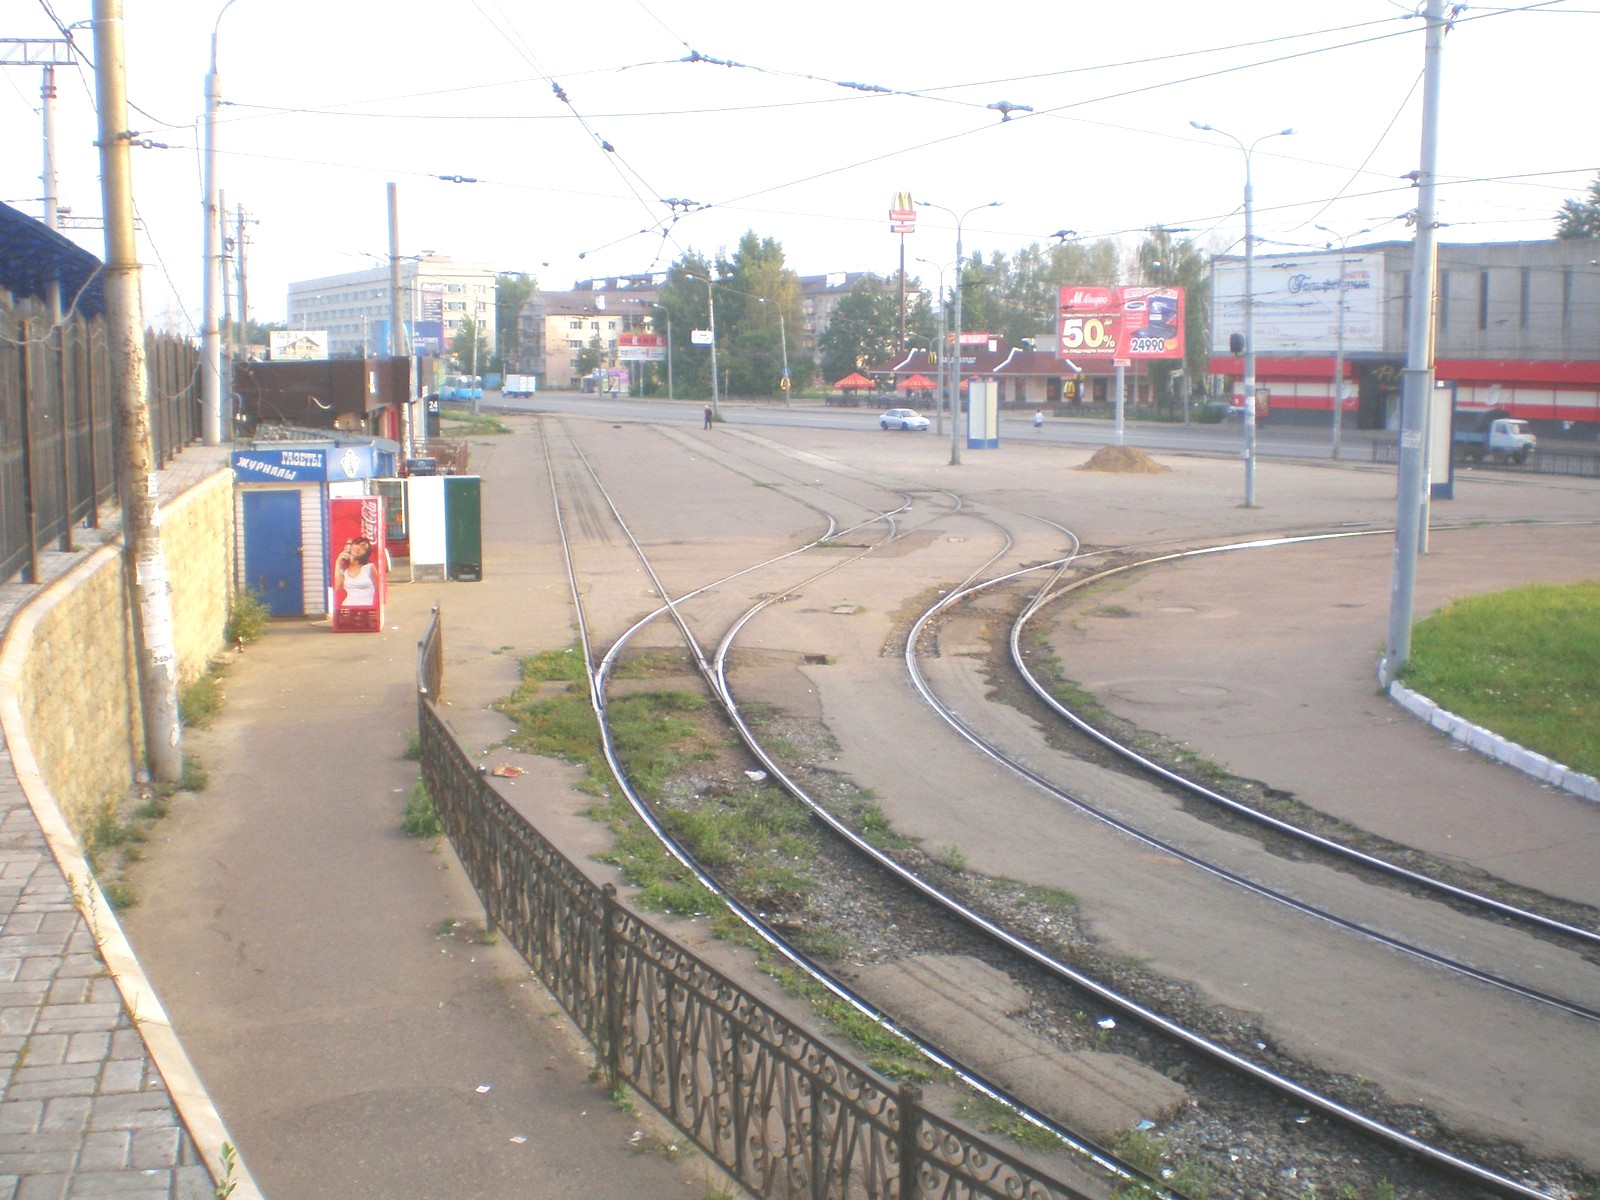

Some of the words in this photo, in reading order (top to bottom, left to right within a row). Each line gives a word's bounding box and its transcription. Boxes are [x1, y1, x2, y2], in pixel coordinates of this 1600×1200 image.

[1131, 339, 1165, 352] 24990
[282, 451, 322, 467] ГАЗЕТЫ
[236, 457, 297, 480] ЖУРНАЛЫ
